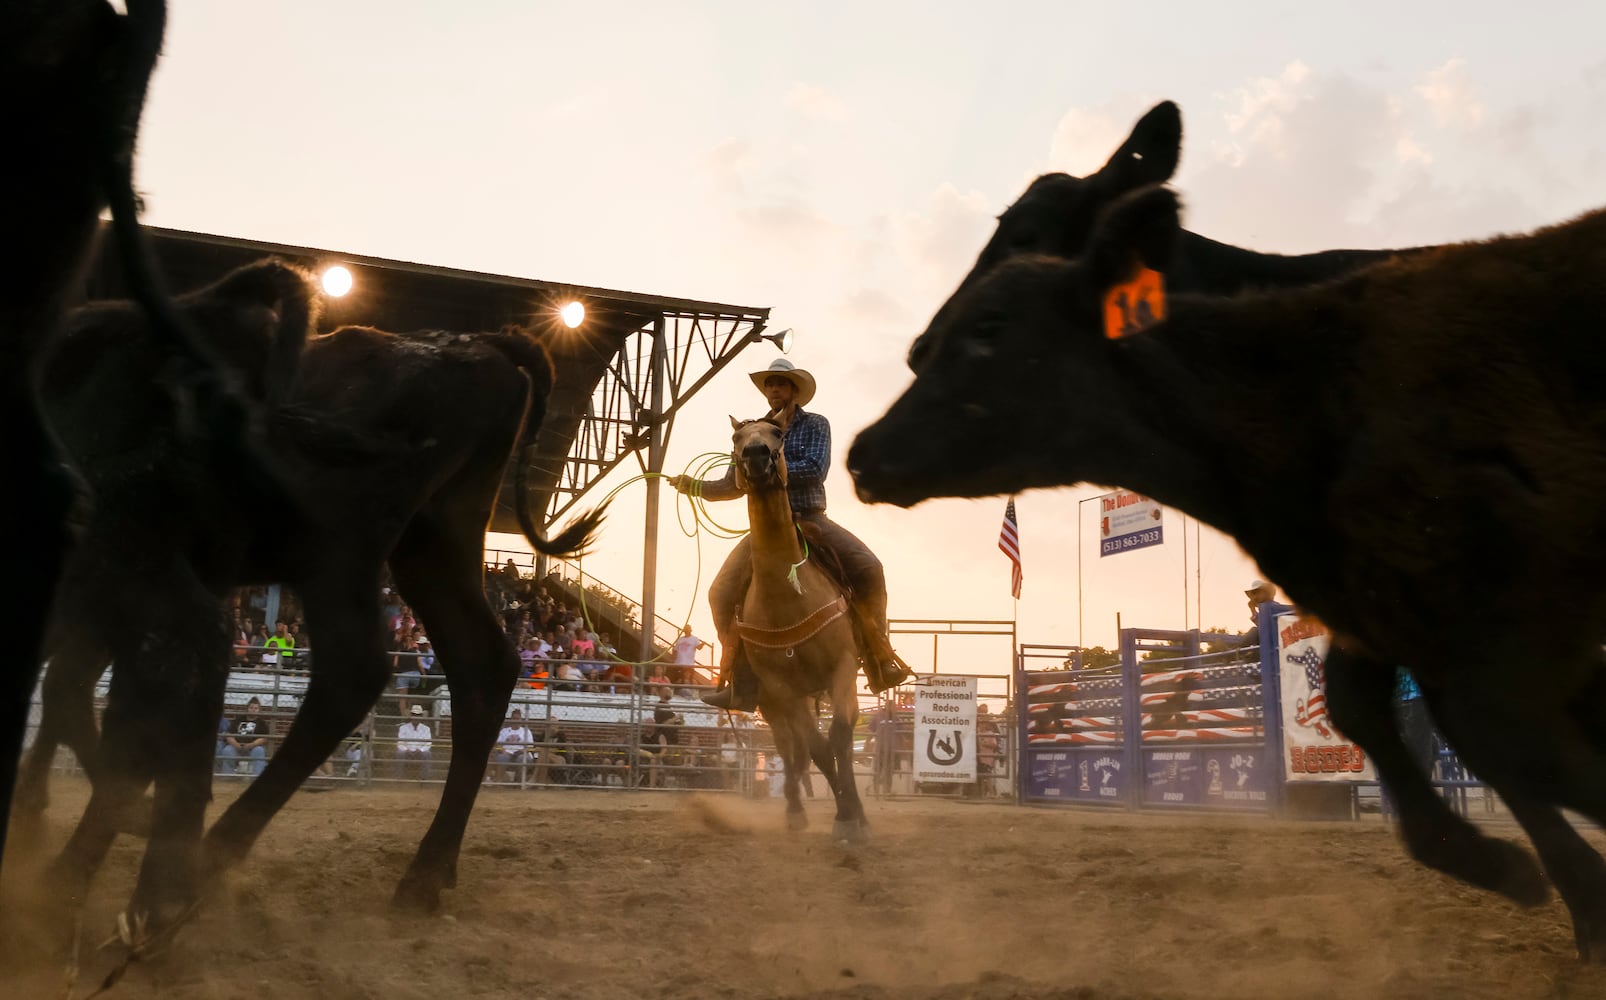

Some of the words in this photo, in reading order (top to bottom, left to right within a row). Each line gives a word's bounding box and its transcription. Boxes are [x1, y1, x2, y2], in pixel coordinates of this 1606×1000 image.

[1103, 498, 1115, 512] The
[1104, 540, 1121, 552] (513)
[1123, 531, 1158, 547] 863-7033
[927, 678, 967, 687] American
[920, 690, 973, 700] Professional
[932, 703, 960, 712] Rodeo
[921, 716, 970, 726] Association
[1290, 745, 1365, 774] RODEO
[1207, 758, 1223, 795] 2
